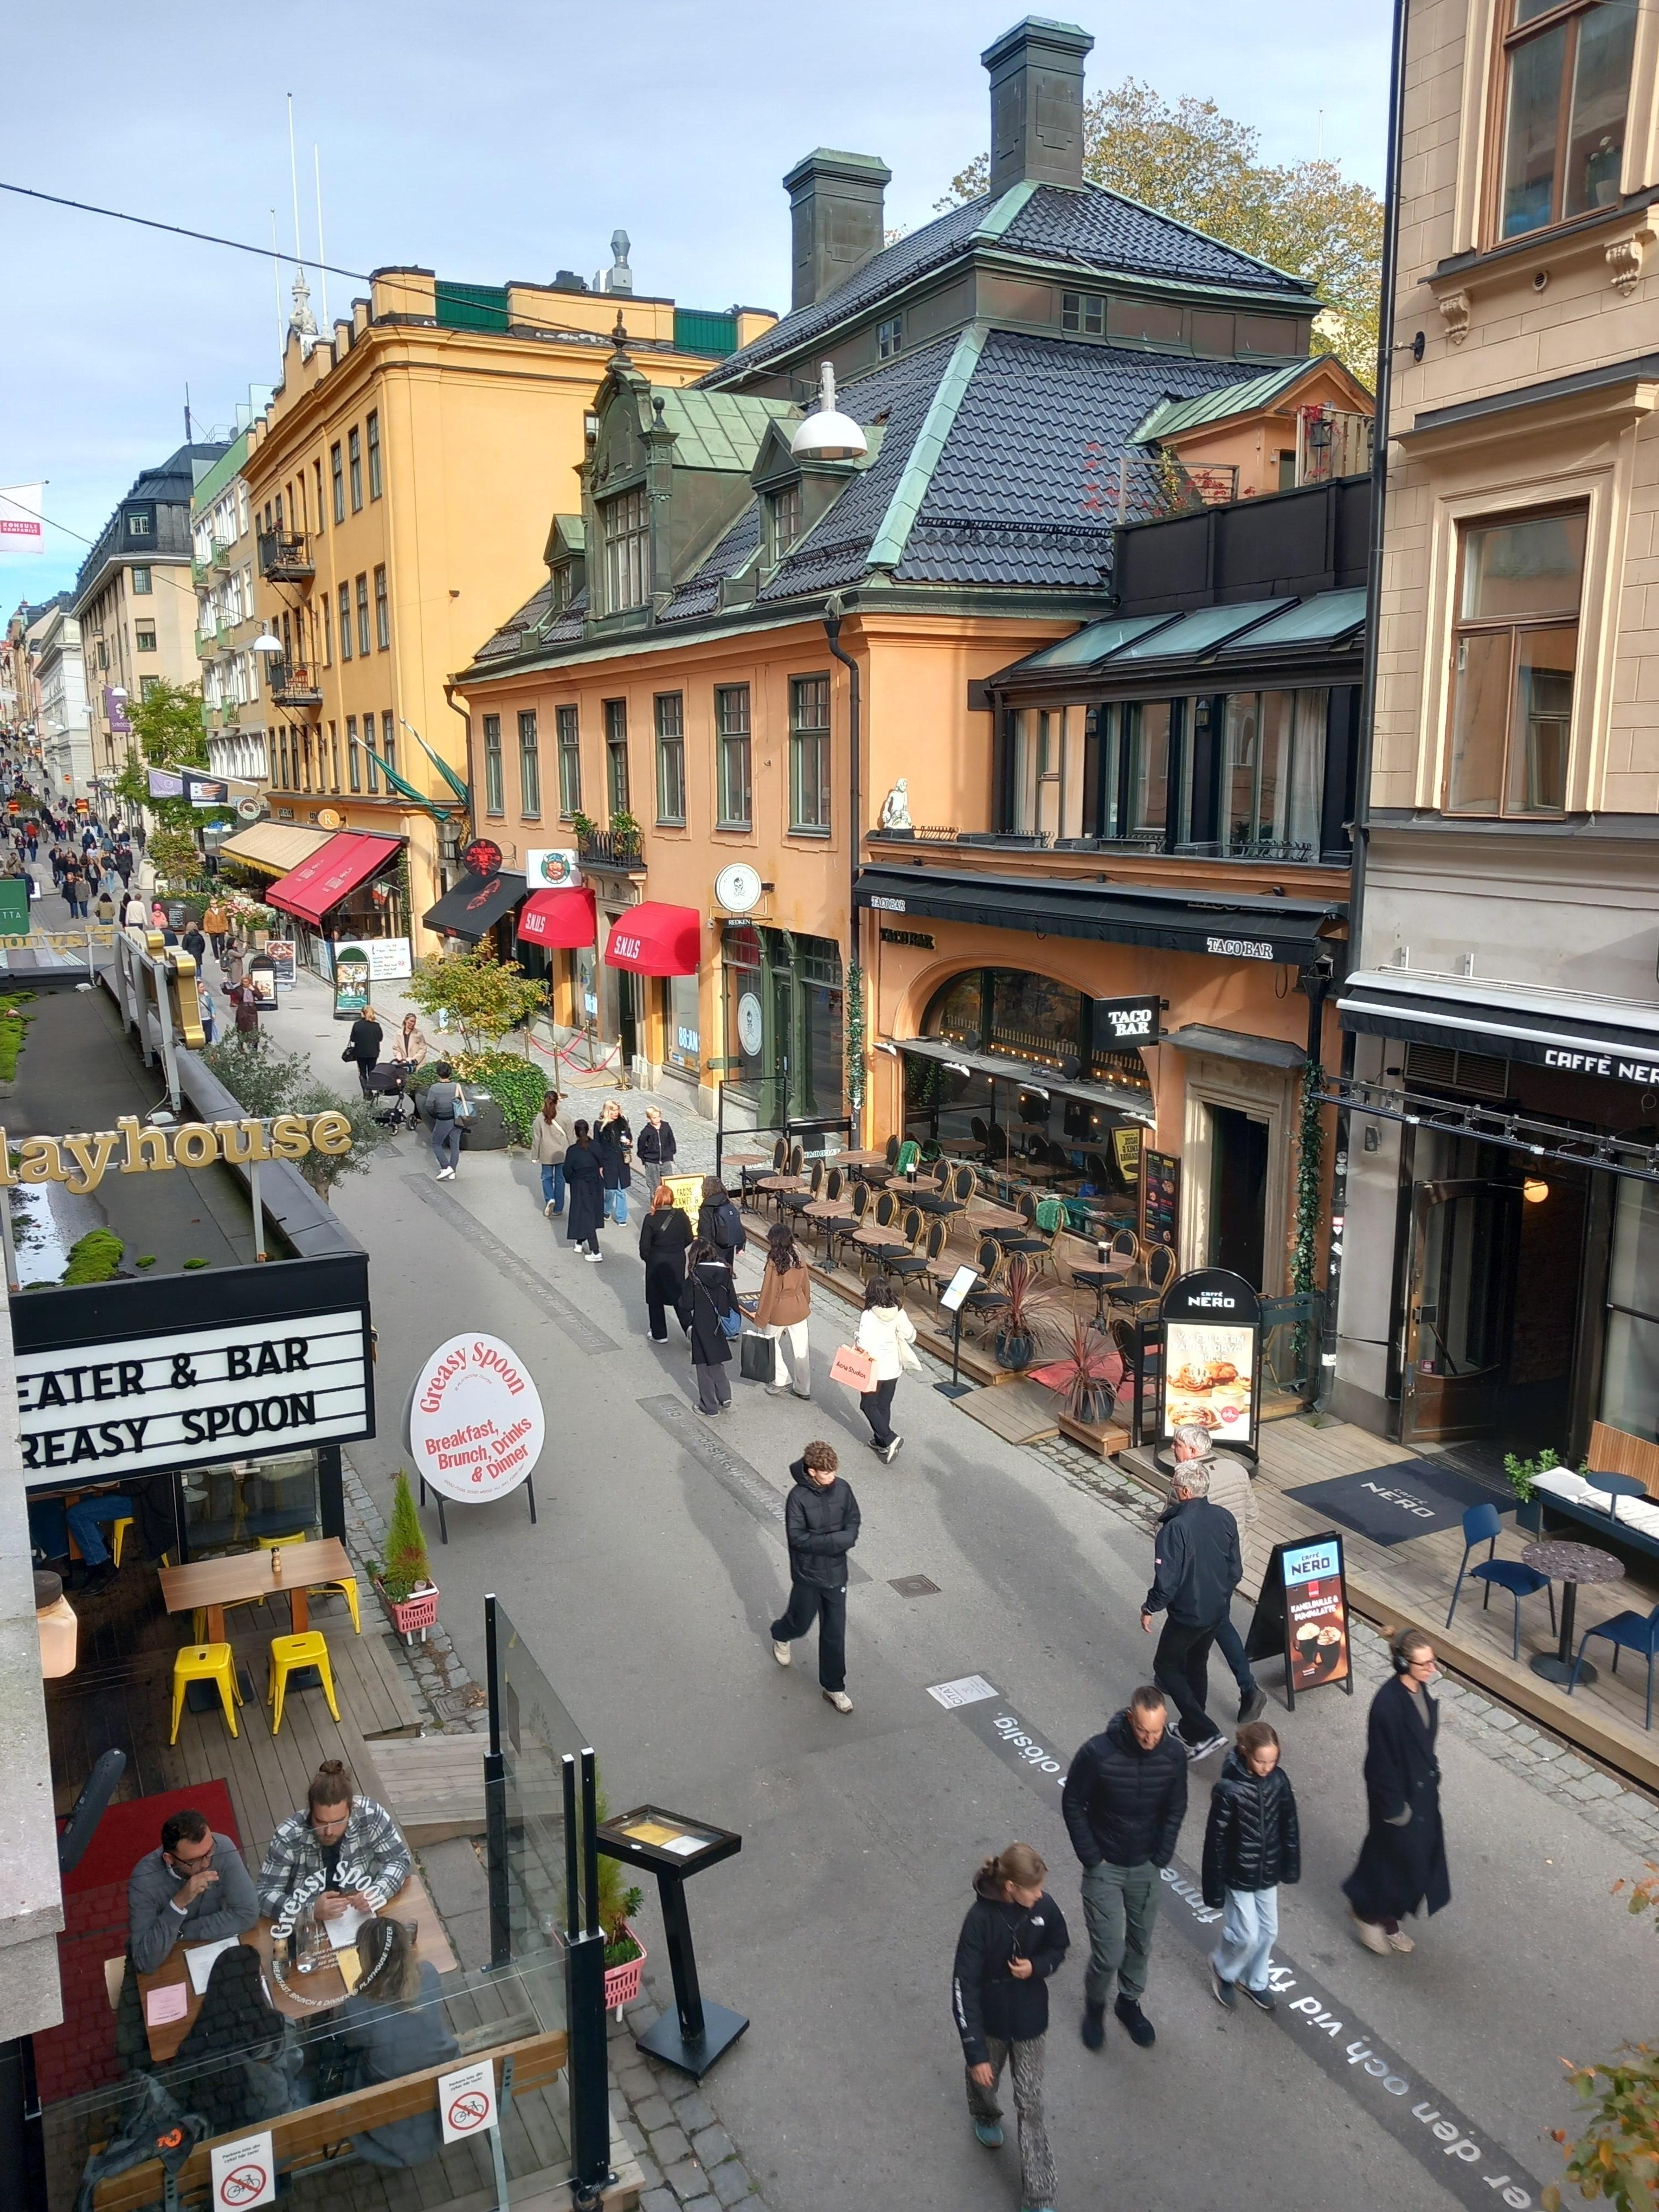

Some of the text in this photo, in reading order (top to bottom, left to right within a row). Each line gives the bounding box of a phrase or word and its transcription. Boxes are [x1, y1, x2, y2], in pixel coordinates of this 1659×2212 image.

[324, 814, 336, 826] R
[871, 896, 905, 911] TACO BAR
[525, 912, 546, 933] S.N.U.S
[614, 935, 641, 959] S.N.U.S
[1207, 937, 1274, 960] TACO BAR
[1108, 1009, 1152, 1024] TACO
[1115, 1022, 1150, 1037] BAR
[1545, 1049, 1612, 1075] CAFFÈ
[1188, 1296, 1235, 1308] NERO
[171, 1352, 197, 1390] &
[227, 1336, 310, 1382] BAR
[837, 1361, 866, 1379] Acne Studios
[420, 1341, 525, 1413] Greasy Spoon
[181, 1390, 316, 1446] SPOON
[660, 1403, 681, 1419] Jag
[425, 1419, 499, 1455] Breakfast,
[438, 1418, 532, 1470] Brunch, Drinks
[471, 1443, 529, 1483] & Dinner
[1360, 1482, 1436, 1517] NERO
[1291, 1557, 1330, 1576] NERO
[938, 1686, 963, 1705] CITAT
[271, 1860, 387, 1939] Greasy Spoon
[288, 1992, 316, 2007] BRUNCH
[359, 1954, 388, 1991] PLAYHOUSE
[384, 1926, 393, 1953] TEATER
[1288, 1996, 1343, 2038] vid
[1346, 2041, 1409, 2095] och
[1411, 2102, 1481, 2162] den
